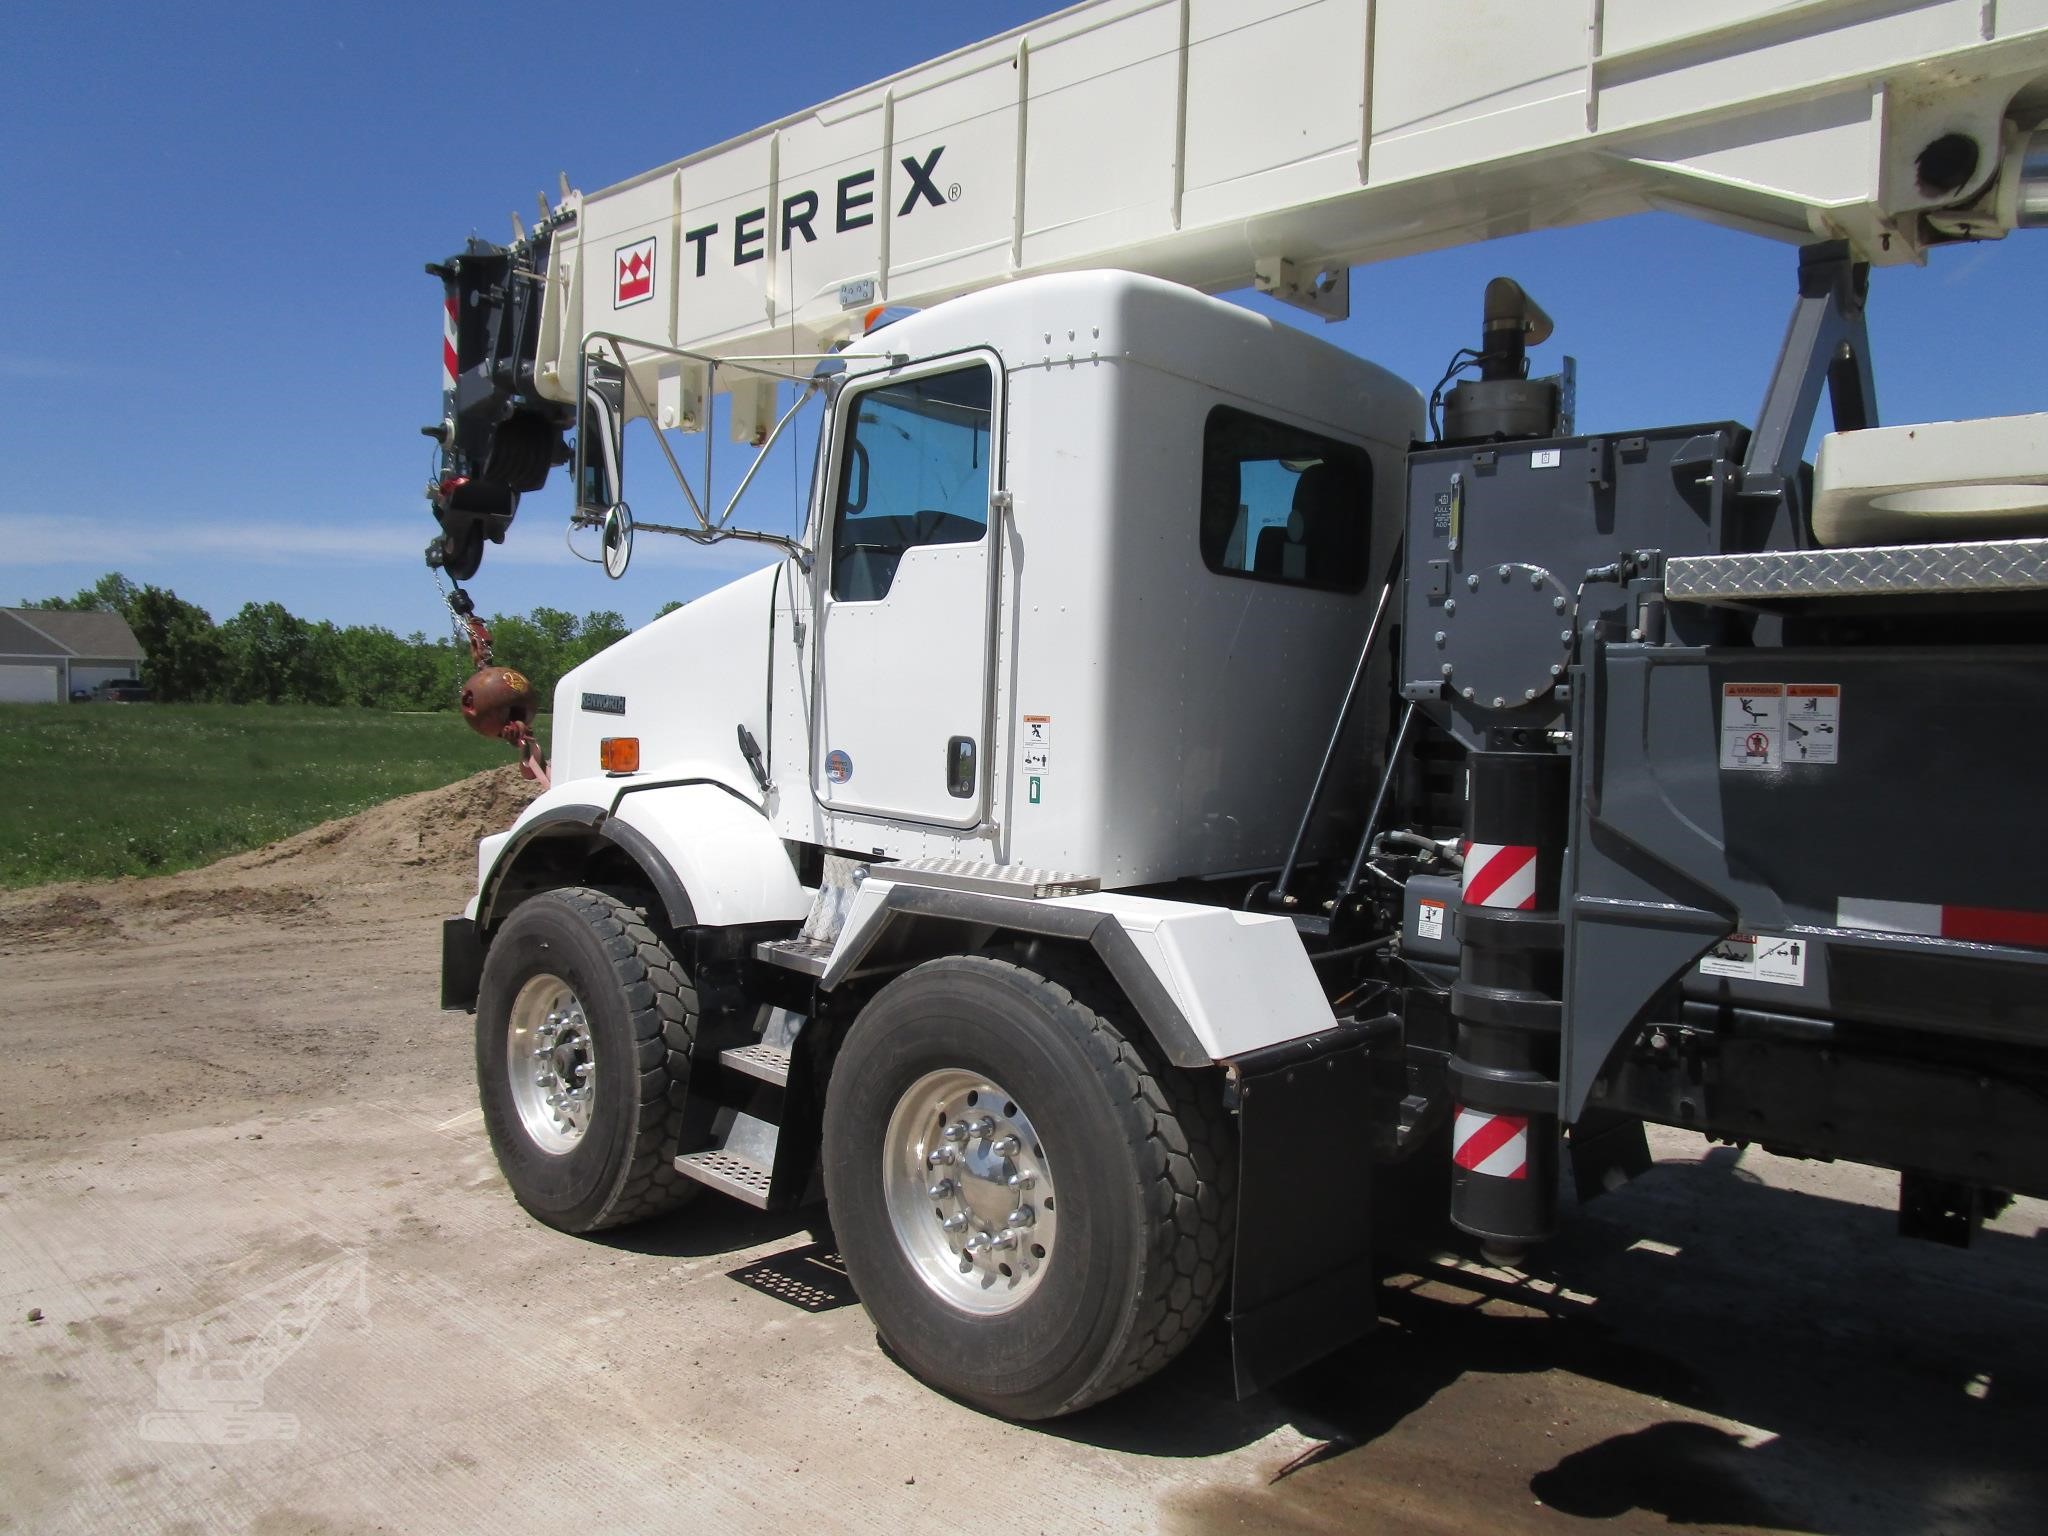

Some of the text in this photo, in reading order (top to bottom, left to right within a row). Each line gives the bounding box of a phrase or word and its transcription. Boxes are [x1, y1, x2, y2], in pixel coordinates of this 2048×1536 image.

[686, 145, 947, 277] TEREX
[1736, 686, 1779, 695] WARNING
[582, 693, 625, 711] KENWORTH
